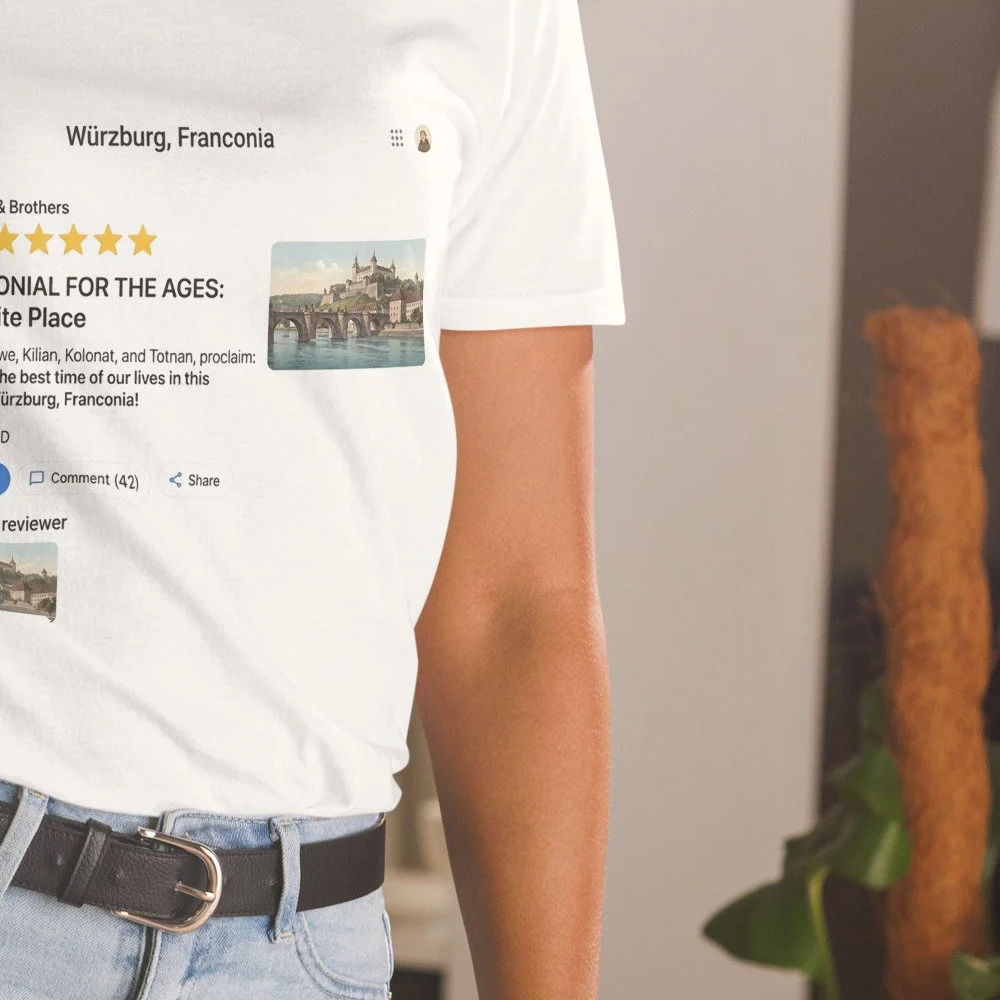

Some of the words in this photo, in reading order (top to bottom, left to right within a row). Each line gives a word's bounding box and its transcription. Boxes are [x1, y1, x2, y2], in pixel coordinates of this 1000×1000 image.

[65, 124, 171, 153] Würzburg,
[178, 126, 275, 149] Franconia
[9, 199, 70, 215] Brothers
[66, 276, 109, 298] FOR
[114, 277, 157, 298] THE
[161, 277, 224, 299] AGES:
[28, 306, 86, 329] Place
[22, 347, 61, 365] Kilian,
[65, 347, 118, 365] Kolonat,
[121, 348, 146, 363] and
[149, 348, 196, 367] Totnan,
[199, 349, 256, 367] proclaim:
[19, 369, 52, 385] best
[54, 369, 86, 385] time
[89, 369, 104, 385] of
[106, 373, 132, 385] our
[134, 369, 166, 386] lives
[169, 370, 182, 386] in
[184, 370, 210, 386] this
[64, 391, 139, 407] Franconia!
[50, 471, 110, 486] Comment
[114, 473, 139, 492] (42)
[188, 473, 221, 487] Share
[1, 515, 68, 532] reviewer
